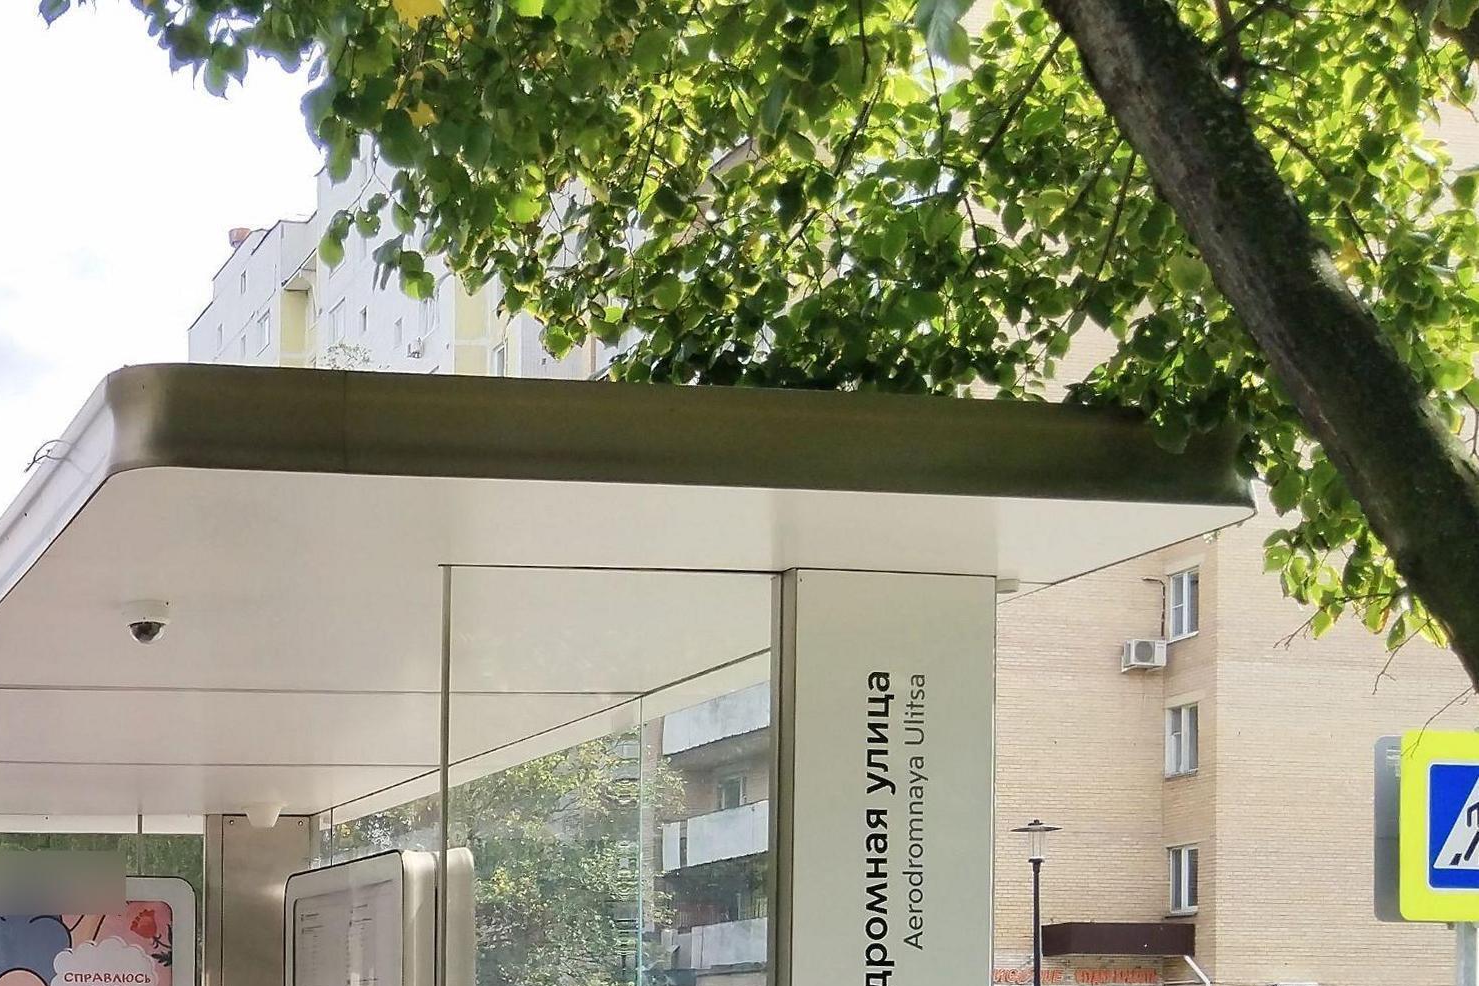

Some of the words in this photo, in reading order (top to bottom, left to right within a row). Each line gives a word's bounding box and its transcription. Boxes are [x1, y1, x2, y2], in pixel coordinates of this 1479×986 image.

[866, 671, 896, 795] улица
[903, 673, 926, 745] Ulitsa
[903, 756, 929, 950] Aerodromnaya
[64, 972, 151, 984] СПРАВЛЮСЬ
